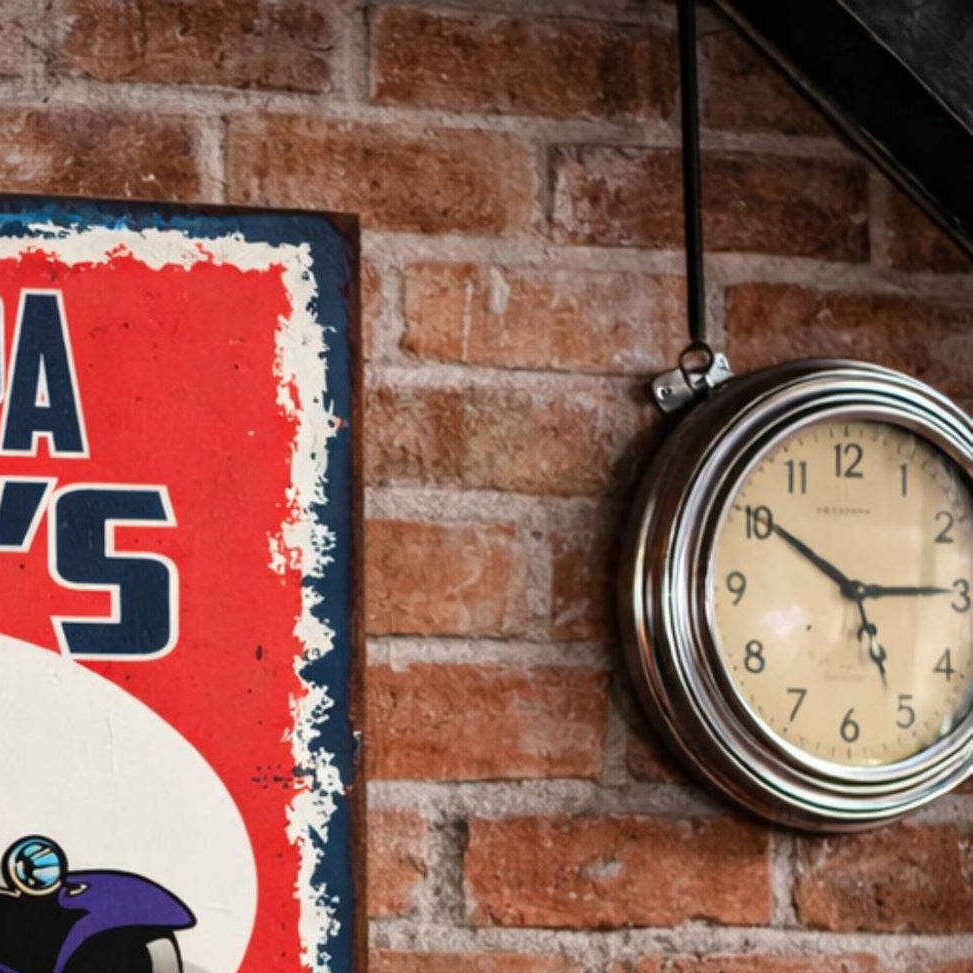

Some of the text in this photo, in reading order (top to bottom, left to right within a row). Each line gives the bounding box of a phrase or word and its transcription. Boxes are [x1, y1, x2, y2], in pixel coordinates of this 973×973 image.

[785, 459, 807, 494] 11
[835, 443, 864, 478] 12
[899, 463, 908, 497] 1
[745, 505, 774, 540] 10
[934, 511, 954, 543] 2
[726, 571, 747, 606] 9
[951, 579, 971, 613] 3
[744, 639, 765, 674] 8
[932, 647, 956, 682] 4
[786, 687, 808, 722] 7
[896, 694, 915, 729] 5
[839, 708, 860, 743] 6
